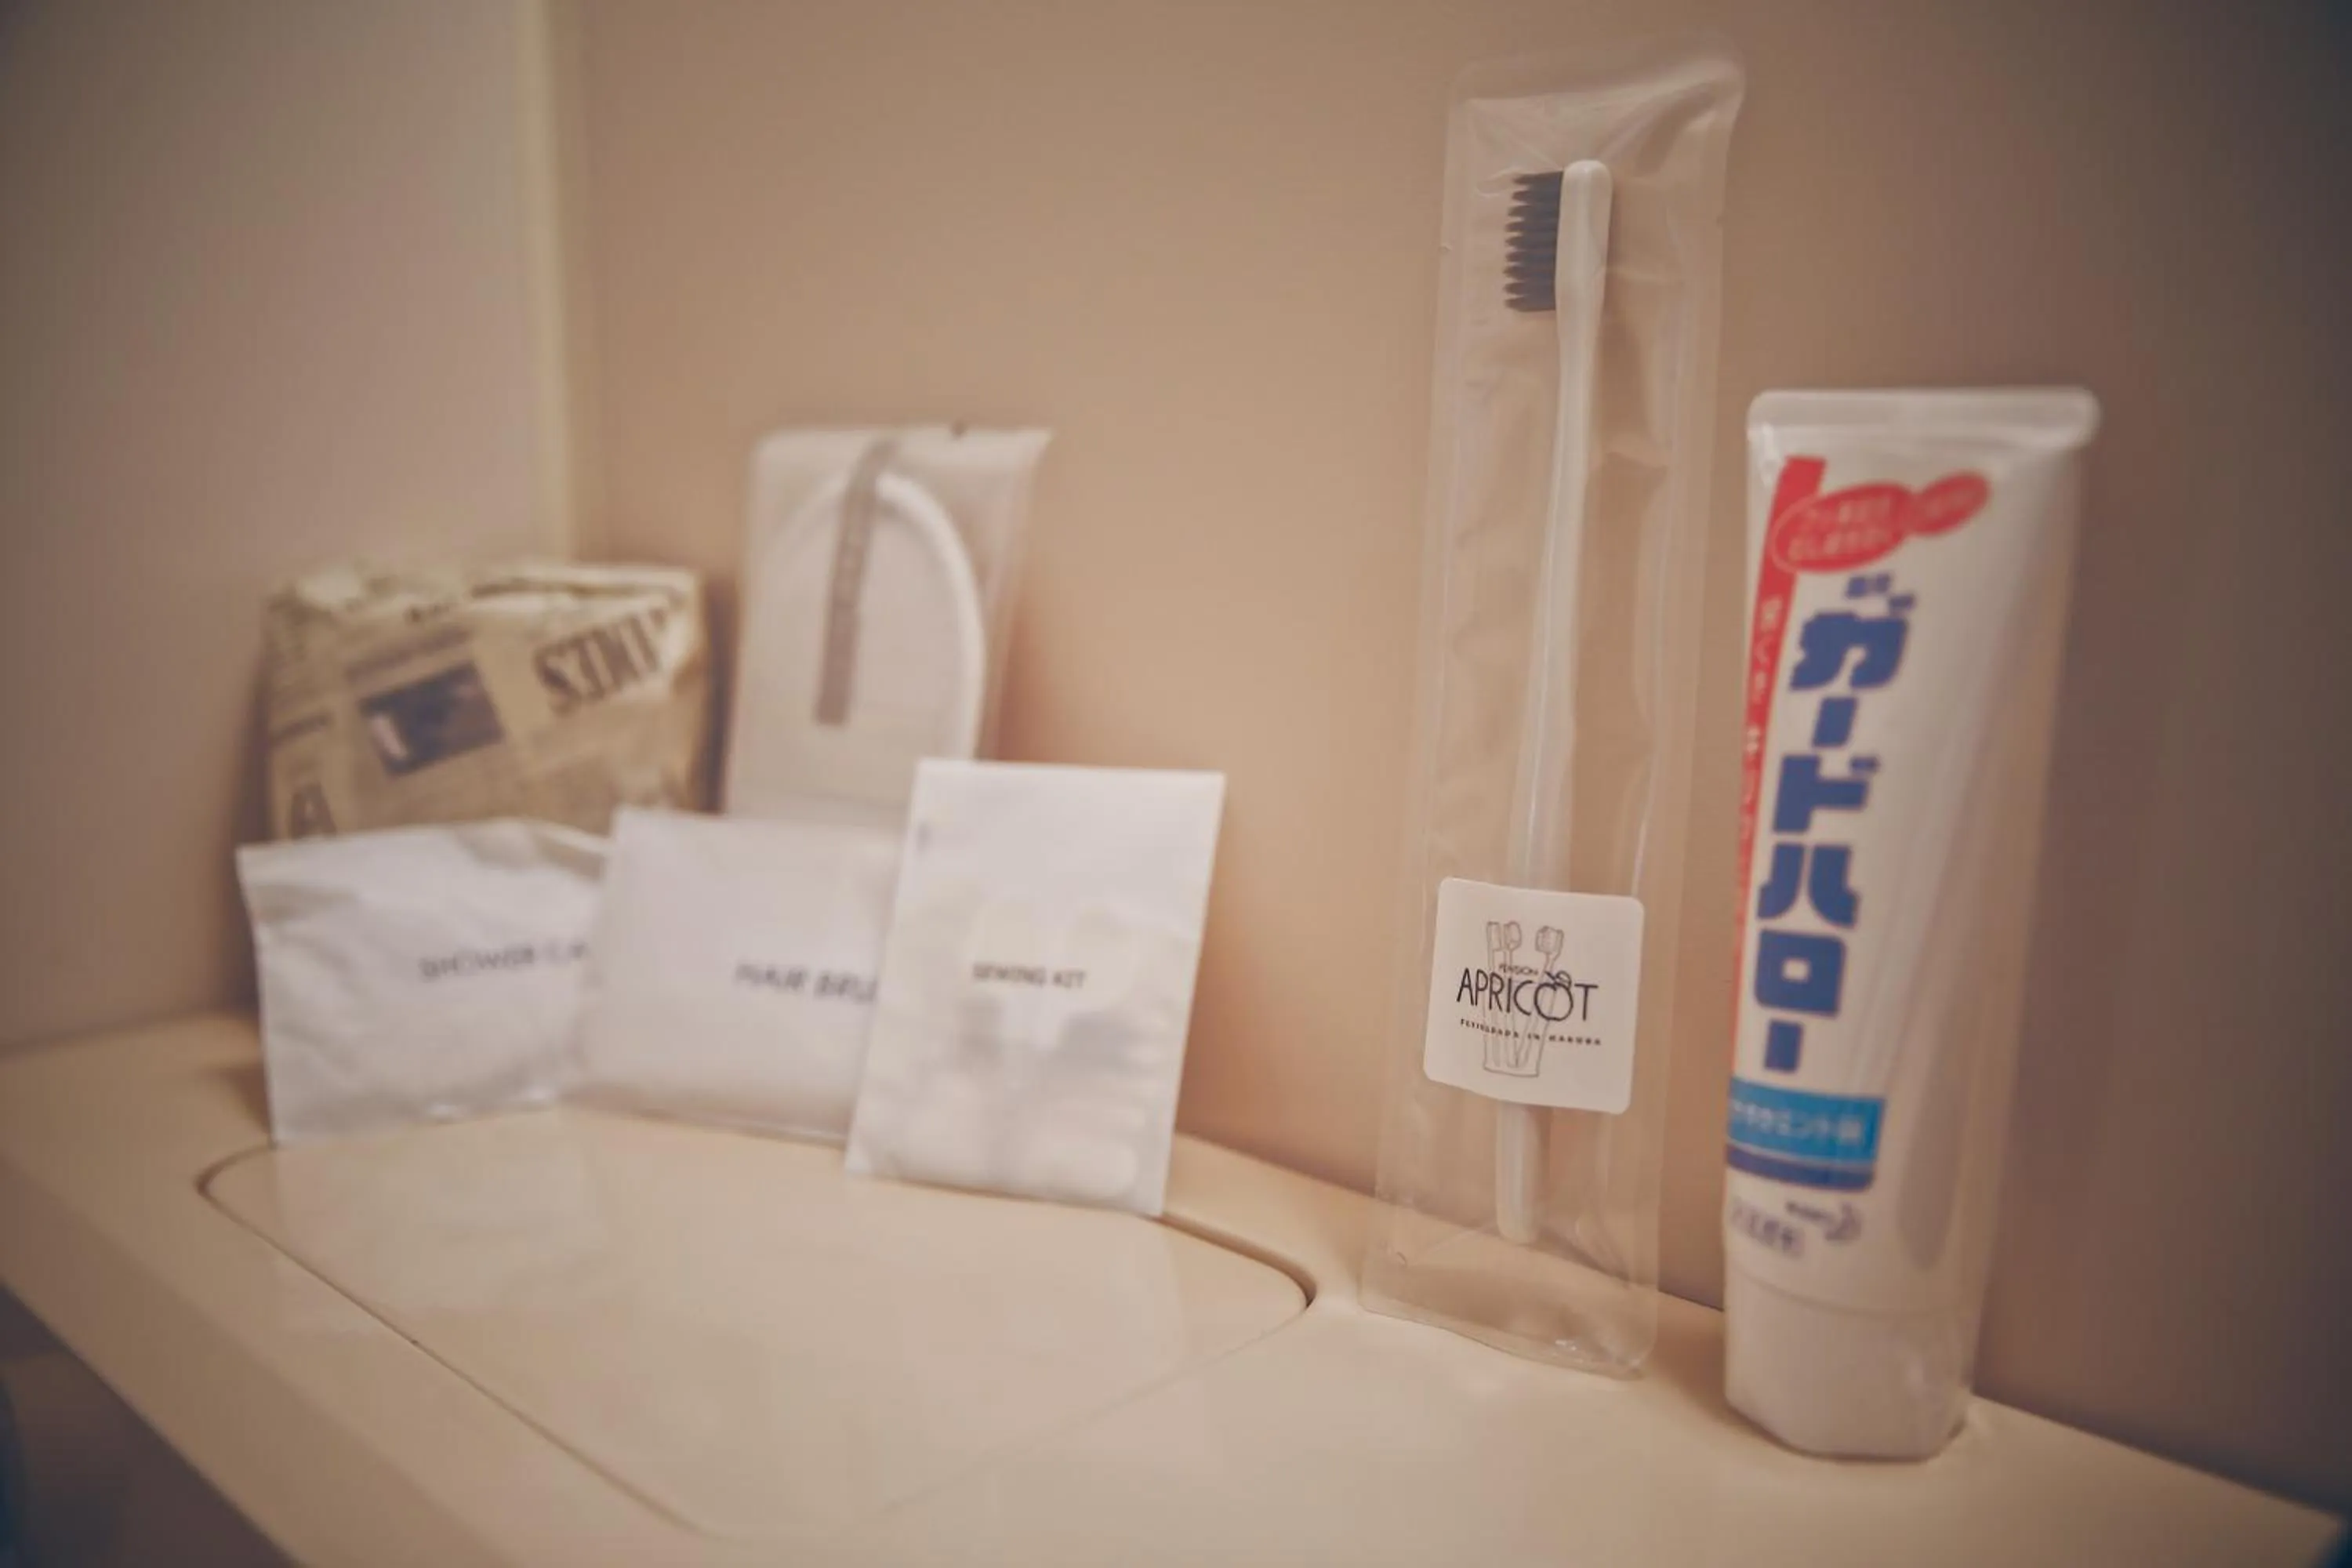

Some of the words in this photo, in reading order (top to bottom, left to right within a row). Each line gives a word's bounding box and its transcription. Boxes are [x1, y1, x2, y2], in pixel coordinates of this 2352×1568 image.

[1752, 572, 1916, 1073] ガードハロー
[972, 962, 1047, 987] SEWING
[1053, 968, 1087, 991] KIT
[1456, 967, 1599, 1022] APRICOT
